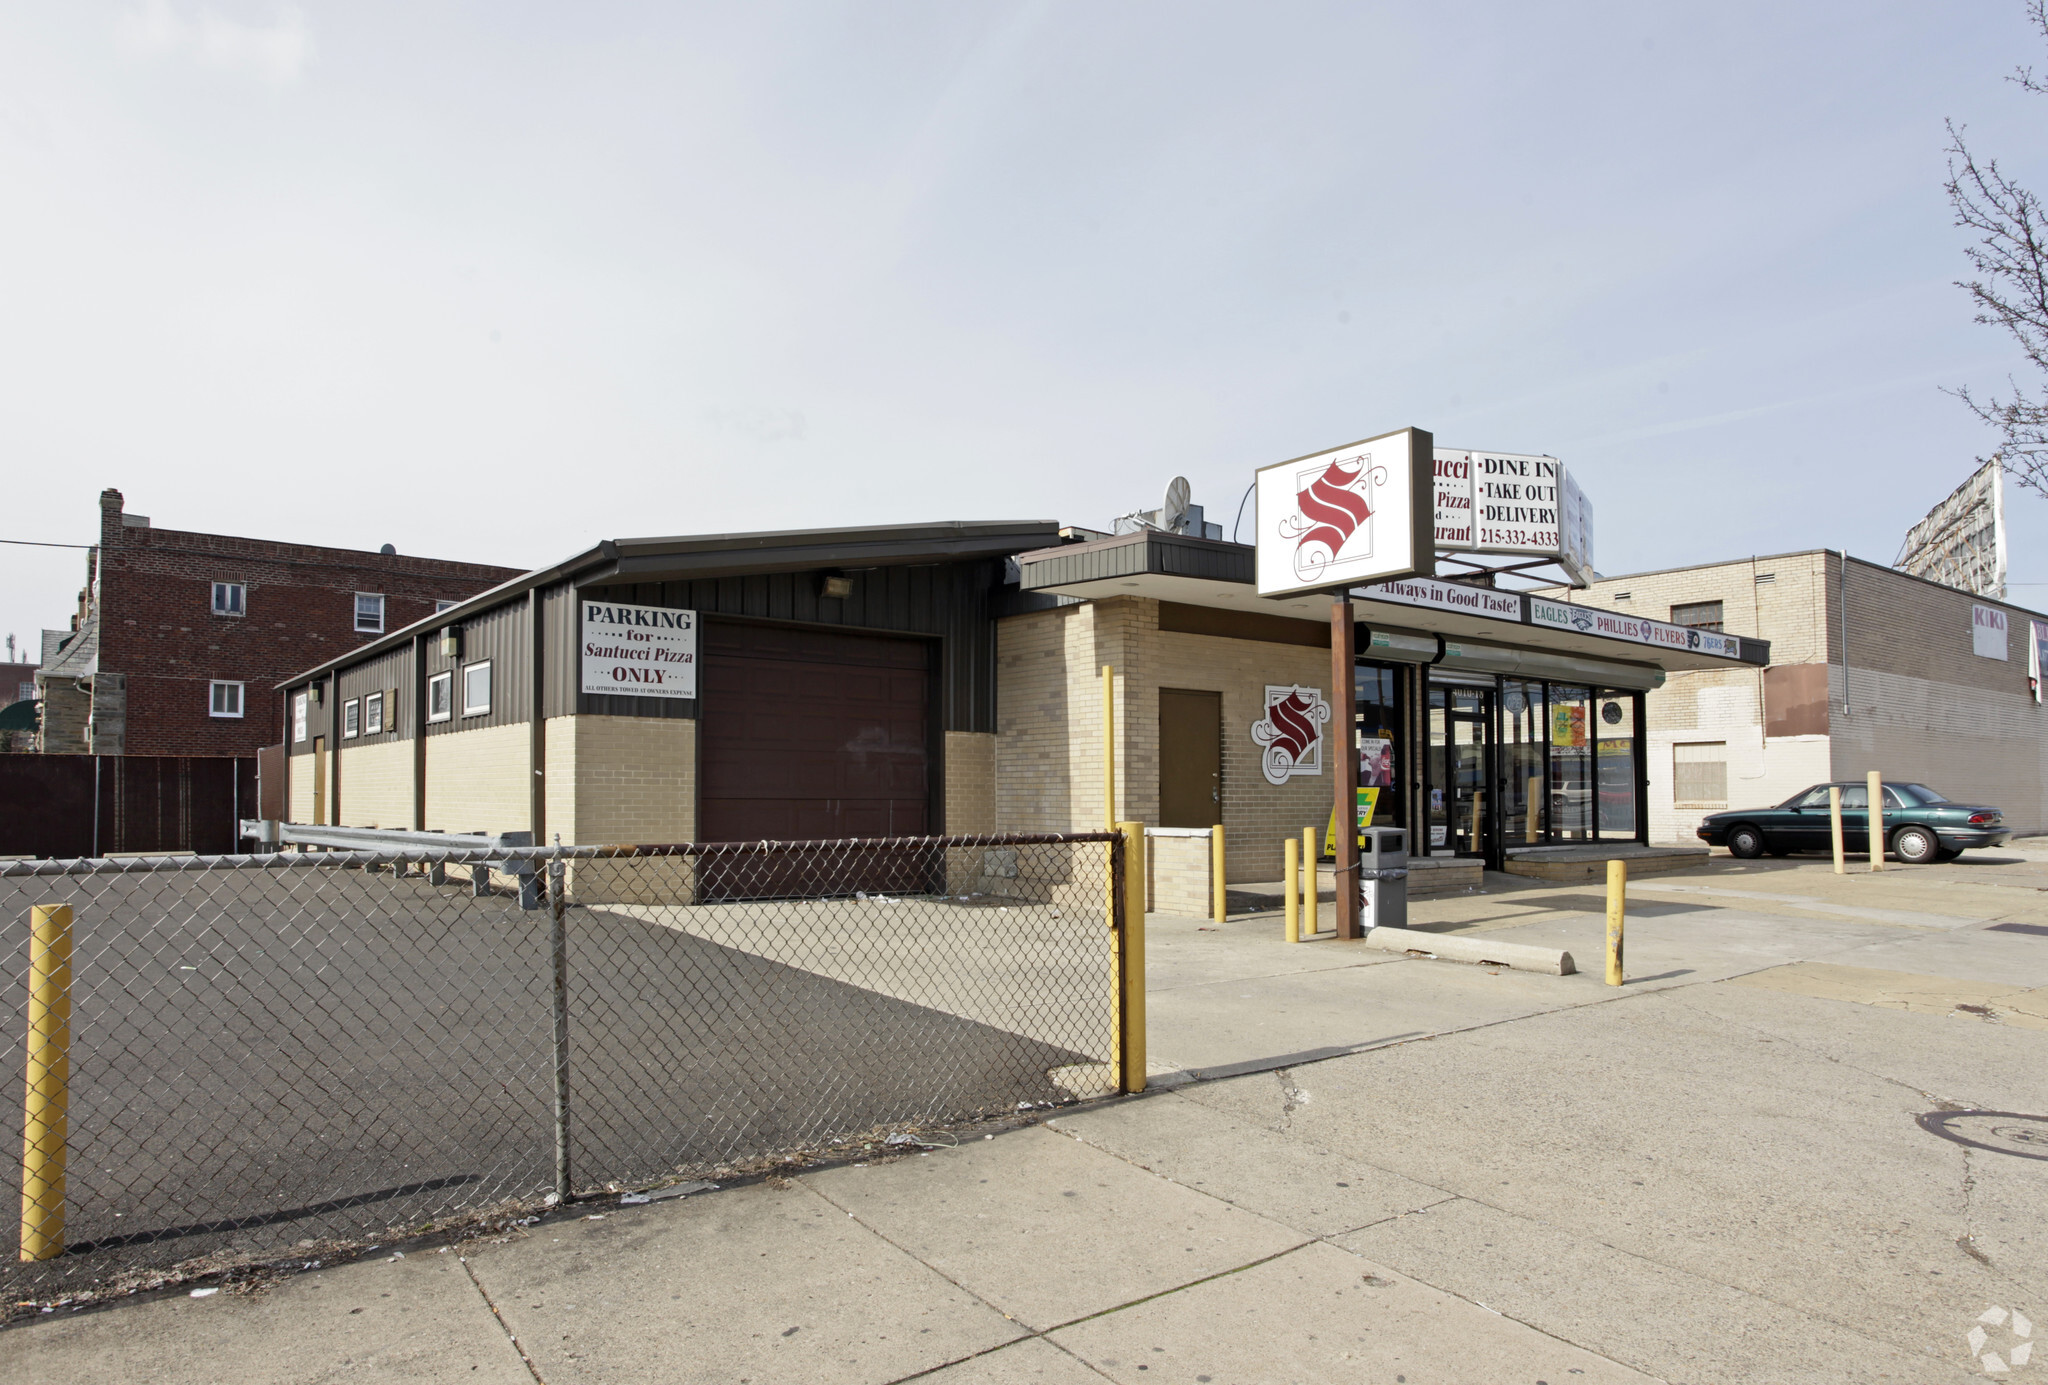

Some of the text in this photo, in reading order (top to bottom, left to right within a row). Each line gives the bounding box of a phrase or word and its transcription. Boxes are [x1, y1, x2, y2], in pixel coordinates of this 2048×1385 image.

[1484, 458, 1554, 478] DINE IN
[1437, 491, 1470, 509] Pizza
[1485, 482, 1556, 501] TAKE OUT
[1486, 505, 1558, 524] DELIVERY
[1481, 528, 1559, 546] 215-332-4333
[1380, 581, 1517, 614] Always in Good Taste!
[587, 605, 691, 630] PARKING
[1535, 604, 1568, 624] EAGLES
[1974, 607, 2004, 630] KIKI
[626, 629, 654, 642] for
[1597, 617, 1638, 637] PHILLIES
[1654, 627, 1685, 645] FLYERS
[1703, 636, 1722, 649] 76ERS
[584, 643, 693, 663] Santucci Pizza
[612, 666, 667, 684] ONLY
